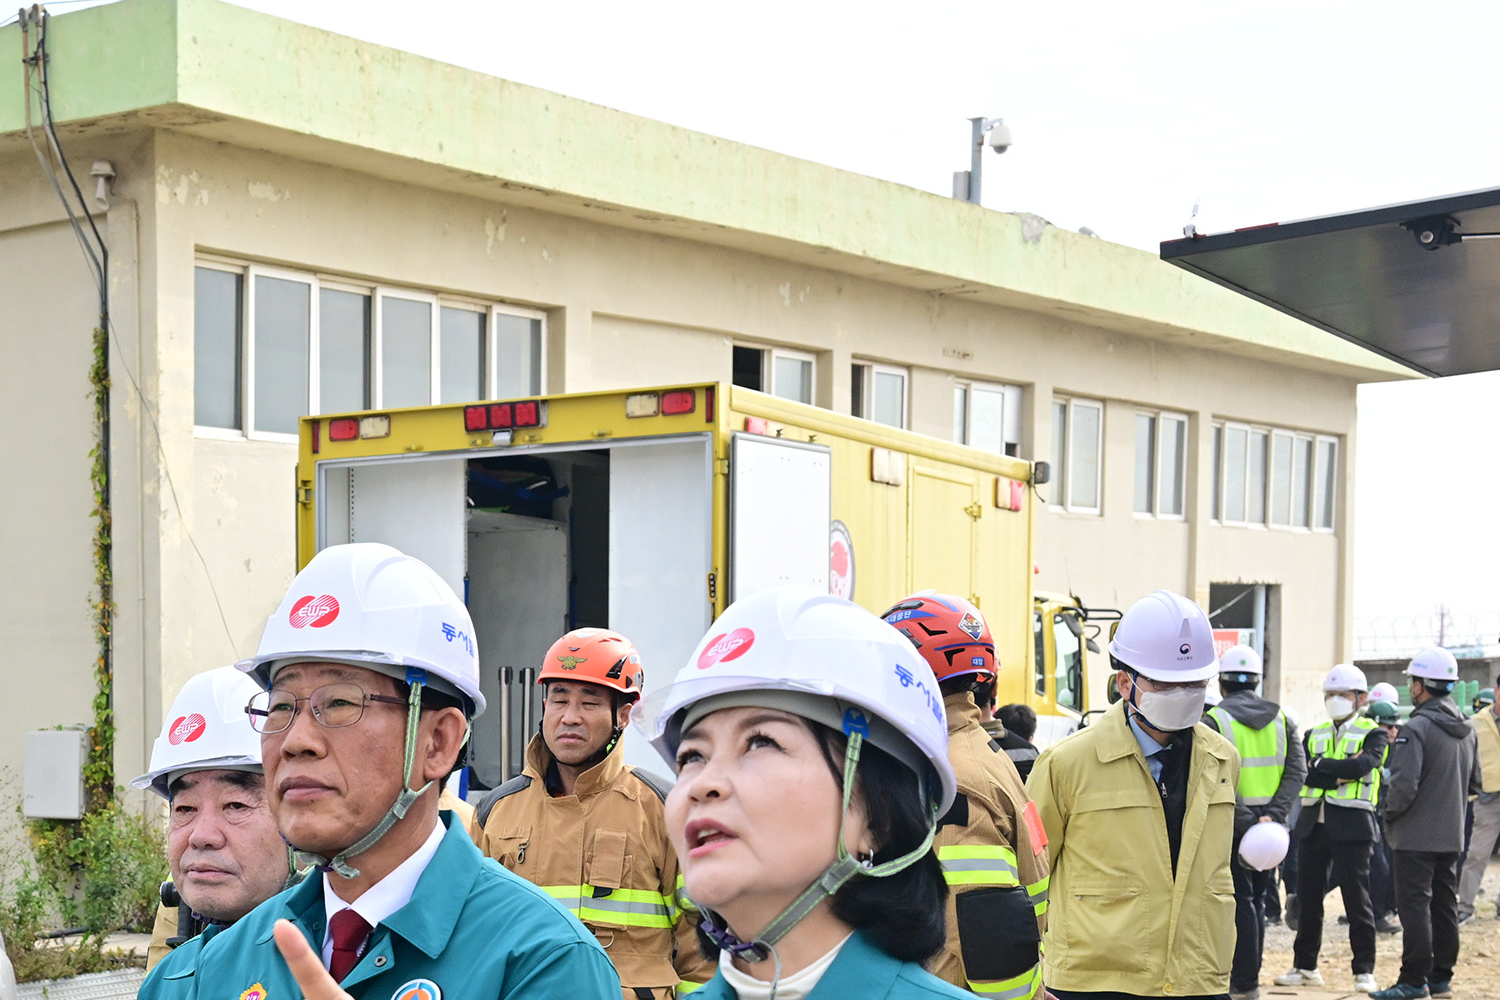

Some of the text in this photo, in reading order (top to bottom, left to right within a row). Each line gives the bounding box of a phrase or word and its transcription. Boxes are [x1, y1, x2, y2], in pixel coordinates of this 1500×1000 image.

[298, 605, 331, 617] EWP
[707, 638, 744, 657] EWP
[174, 723, 199, 736] EWP
